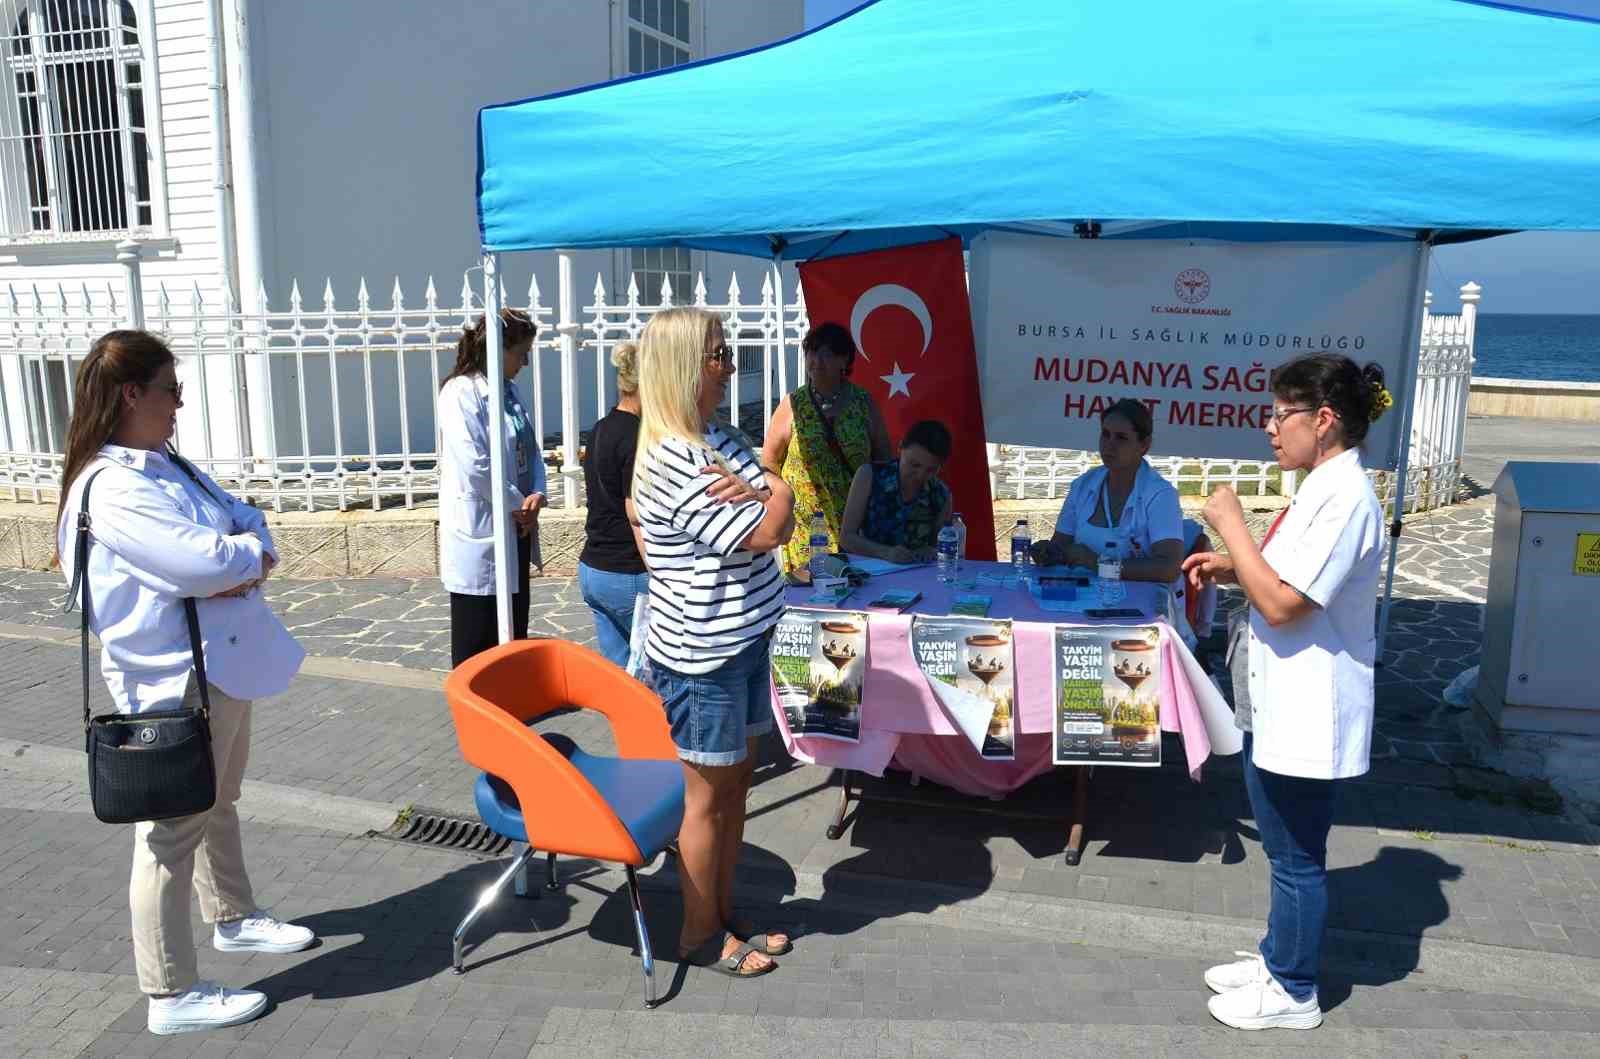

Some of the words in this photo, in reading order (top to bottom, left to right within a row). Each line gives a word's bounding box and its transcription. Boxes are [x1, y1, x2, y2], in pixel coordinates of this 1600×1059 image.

[1017, 324, 1085, 339] BURSA
[1100, 324, 1119, 340] İL
[1131, 327, 1209, 344] SAĞLIK
[1223, 332, 1365, 350] MÜDÜRLÜĞÜ
[1033, 356, 1193, 390] MUDANYA
[776, 623, 813, 634] TAKVİM
[776, 632, 813, 646] YAŞIN
[918, 640, 957, 650] TAKVİM
[773, 645, 811, 657] DEĞİL
[1062, 645, 1103, 655] TAKVİM
[919, 650, 957, 664] YAŞIN
[1063, 655, 1103, 668] YAŞIN
[1062, 667, 1103, 680] DEĞİL
